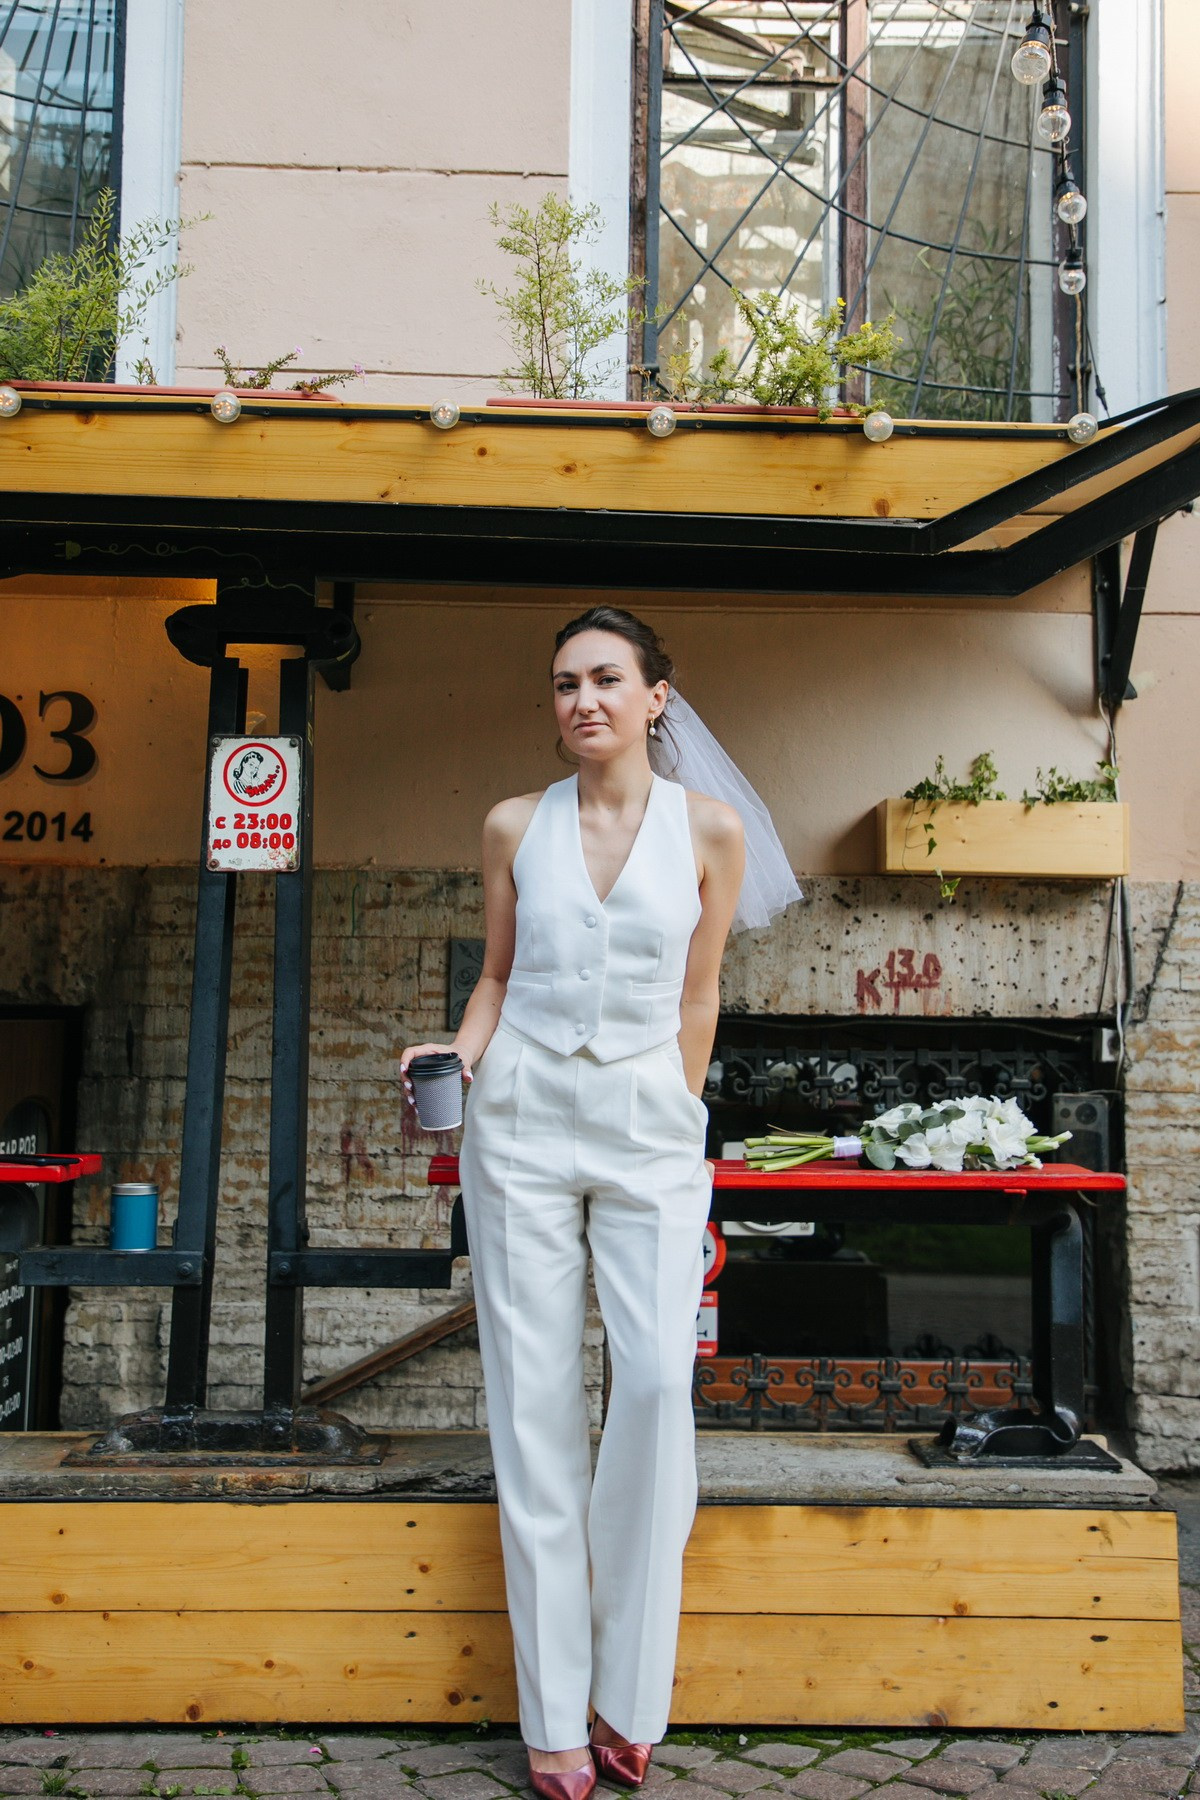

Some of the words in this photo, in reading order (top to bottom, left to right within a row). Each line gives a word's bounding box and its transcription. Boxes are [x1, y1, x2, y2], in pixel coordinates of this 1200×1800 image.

[2, 810, 94, 842] 2014
[233, 813, 292, 830] 23:00
[212, 838, 232, 850] до
[236, 832, 295, 850] 08:00
